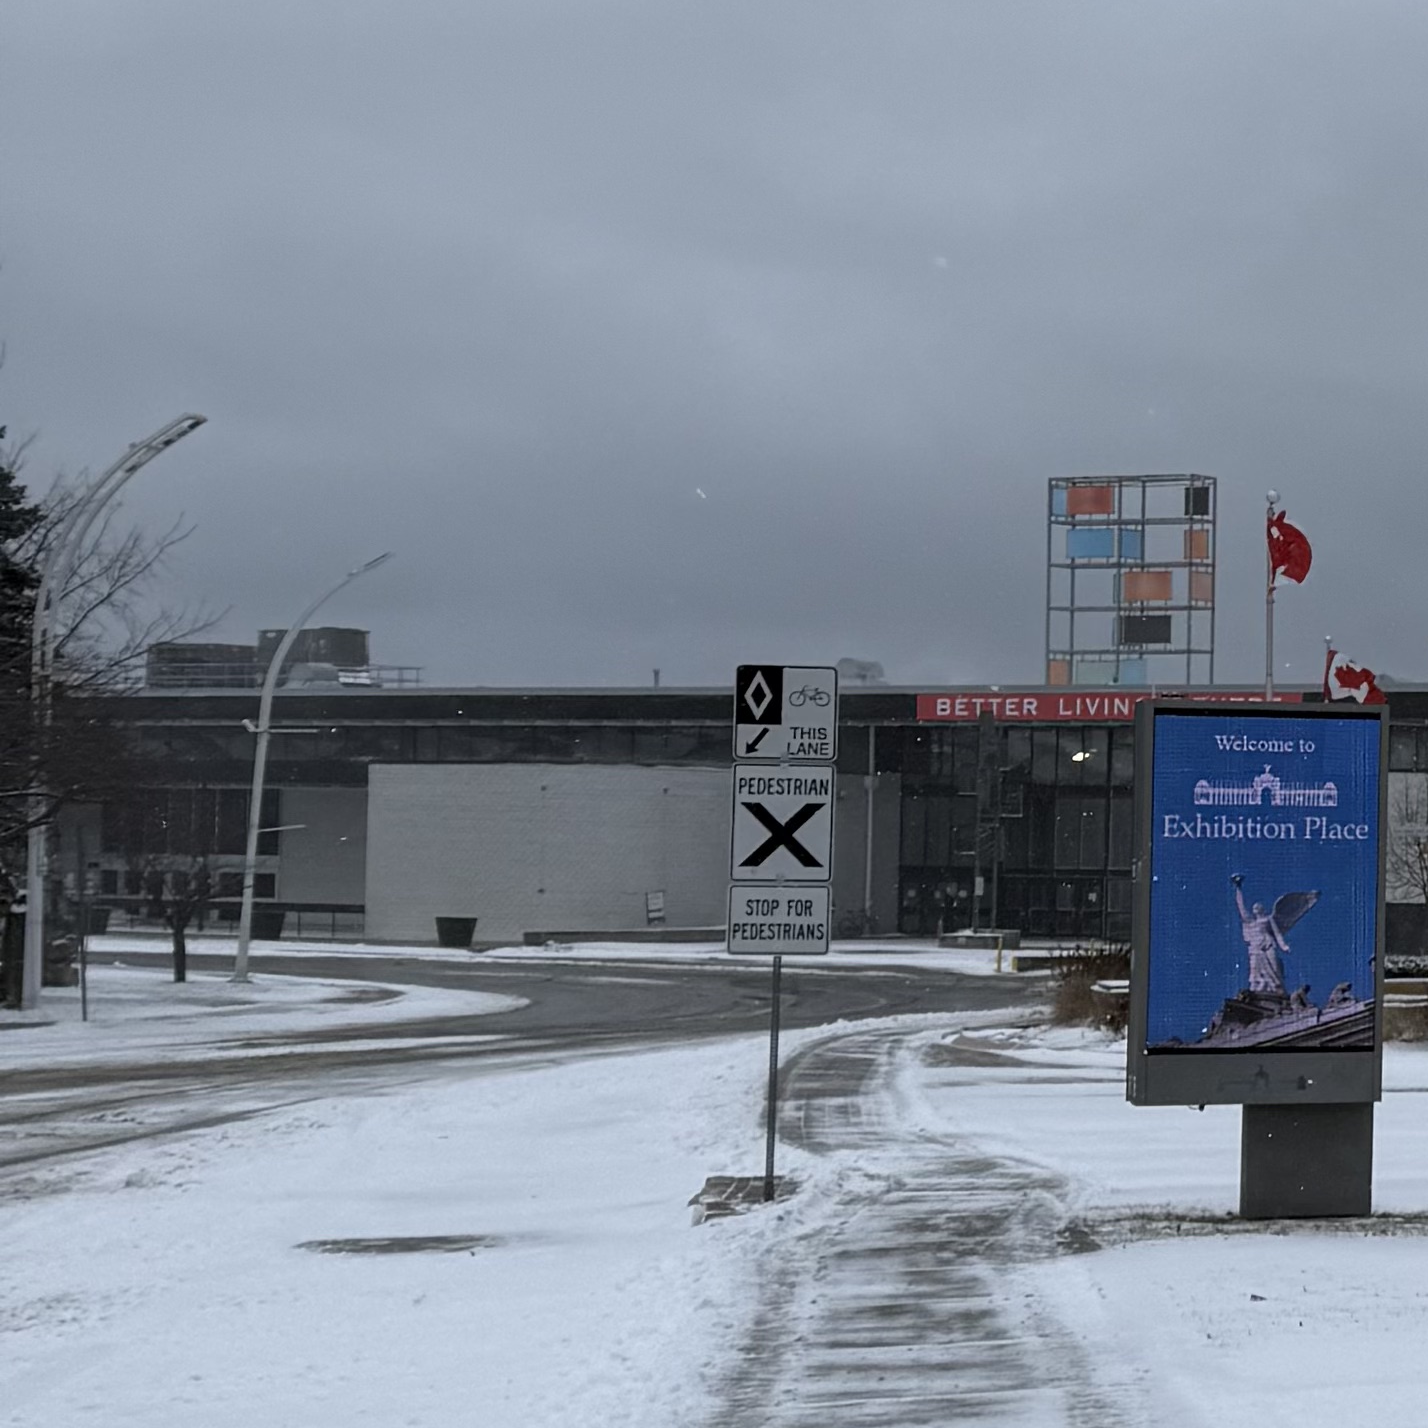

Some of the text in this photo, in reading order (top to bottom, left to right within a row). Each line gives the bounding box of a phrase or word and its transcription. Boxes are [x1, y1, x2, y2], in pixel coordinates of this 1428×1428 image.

[936, 697, 1143, 717] BETTER LIVIN
[790, 726, 828, 740] THIS
[787, 742, 830, 756] LANE
[1215, 735, 1315, 753] Welcome to
[738, 777, 829, 796] PEDESTRIAN
[1163, 813, 1369, 840] Exhibition Place
[745, 899, 813, 917] STOP FOR
[732, 923, 825, 941] PEDESTRIANS
